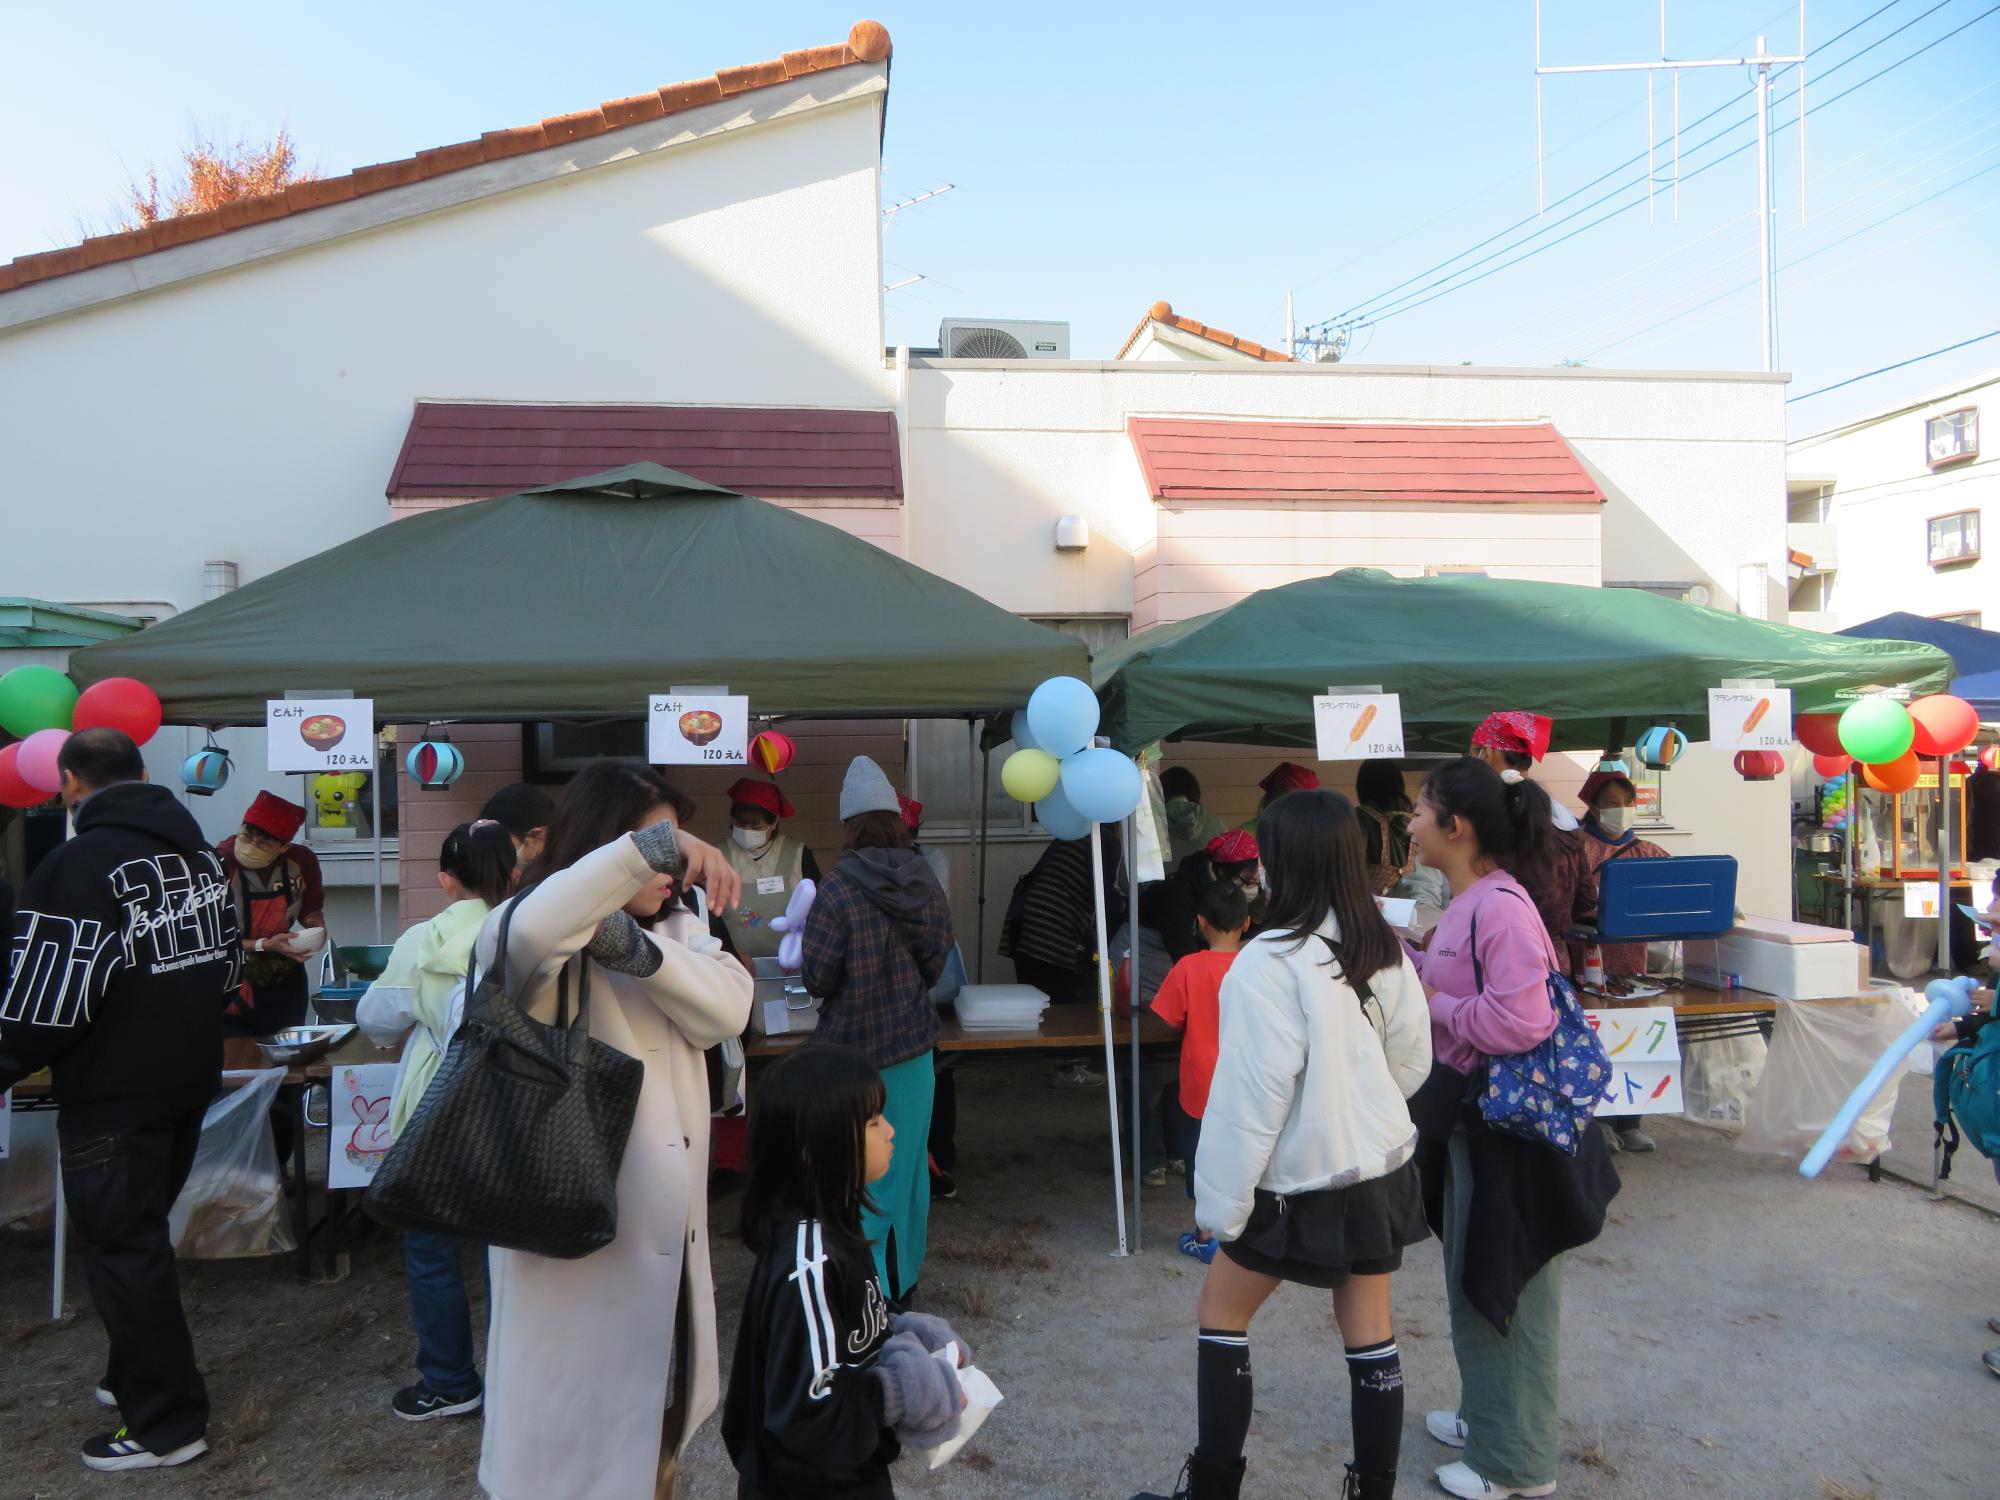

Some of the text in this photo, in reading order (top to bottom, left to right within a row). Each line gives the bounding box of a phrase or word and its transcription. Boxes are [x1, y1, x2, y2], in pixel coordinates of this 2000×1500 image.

[273, 707, 304, 717] とん汁
[654, 702, 683, 712] とん汁
